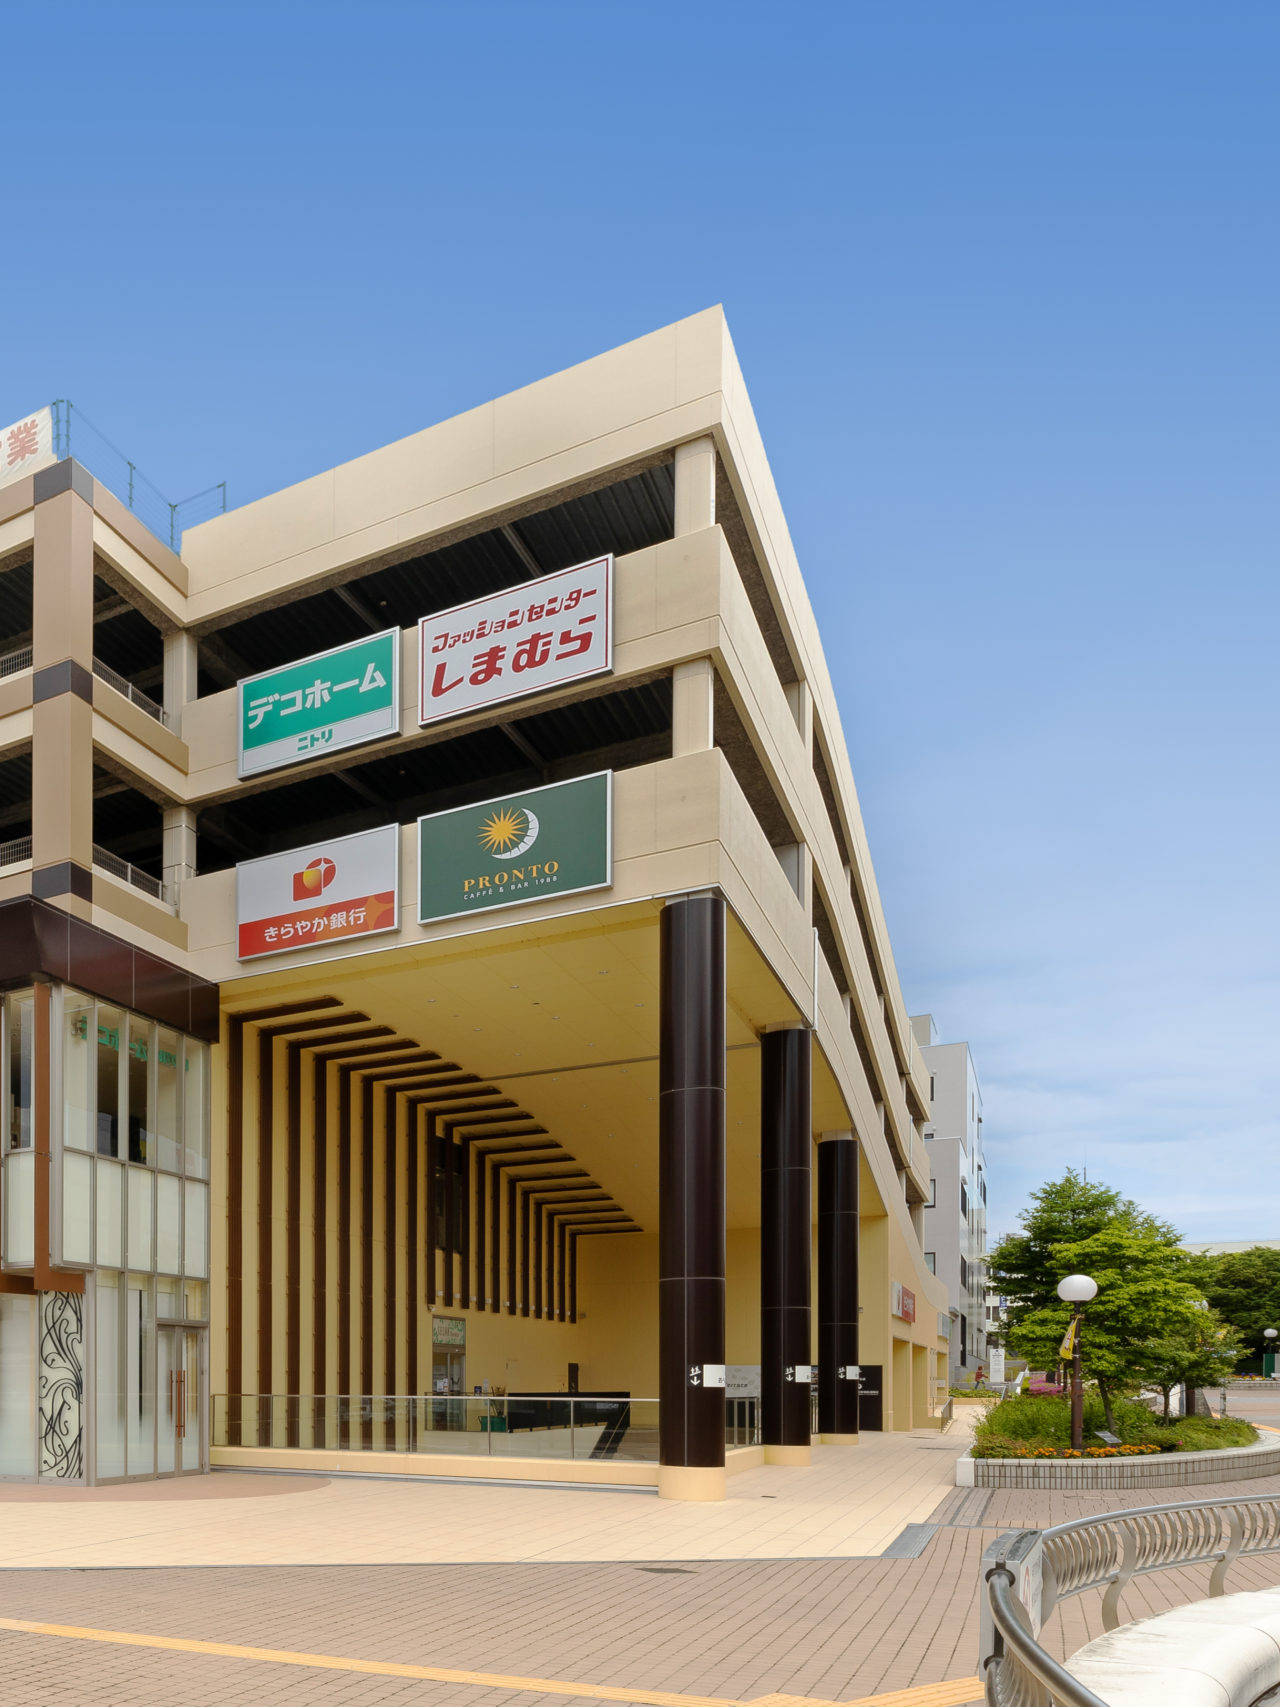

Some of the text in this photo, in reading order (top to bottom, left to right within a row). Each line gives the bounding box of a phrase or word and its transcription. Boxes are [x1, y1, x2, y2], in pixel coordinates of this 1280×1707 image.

[431, 588, 597, 654] ファッションセンター
[431, 614, 597, 698] しまむら
[247, 662, 387, 730] デコホーム
[296, 728, 334, 752] ニトリ
[463, 860, 560, 893] PRONTO
[510, 881, 529, 890] BAR
[535, 875, 558, 885] 1988
[263, 907, 368, 943] きらやか銀行
